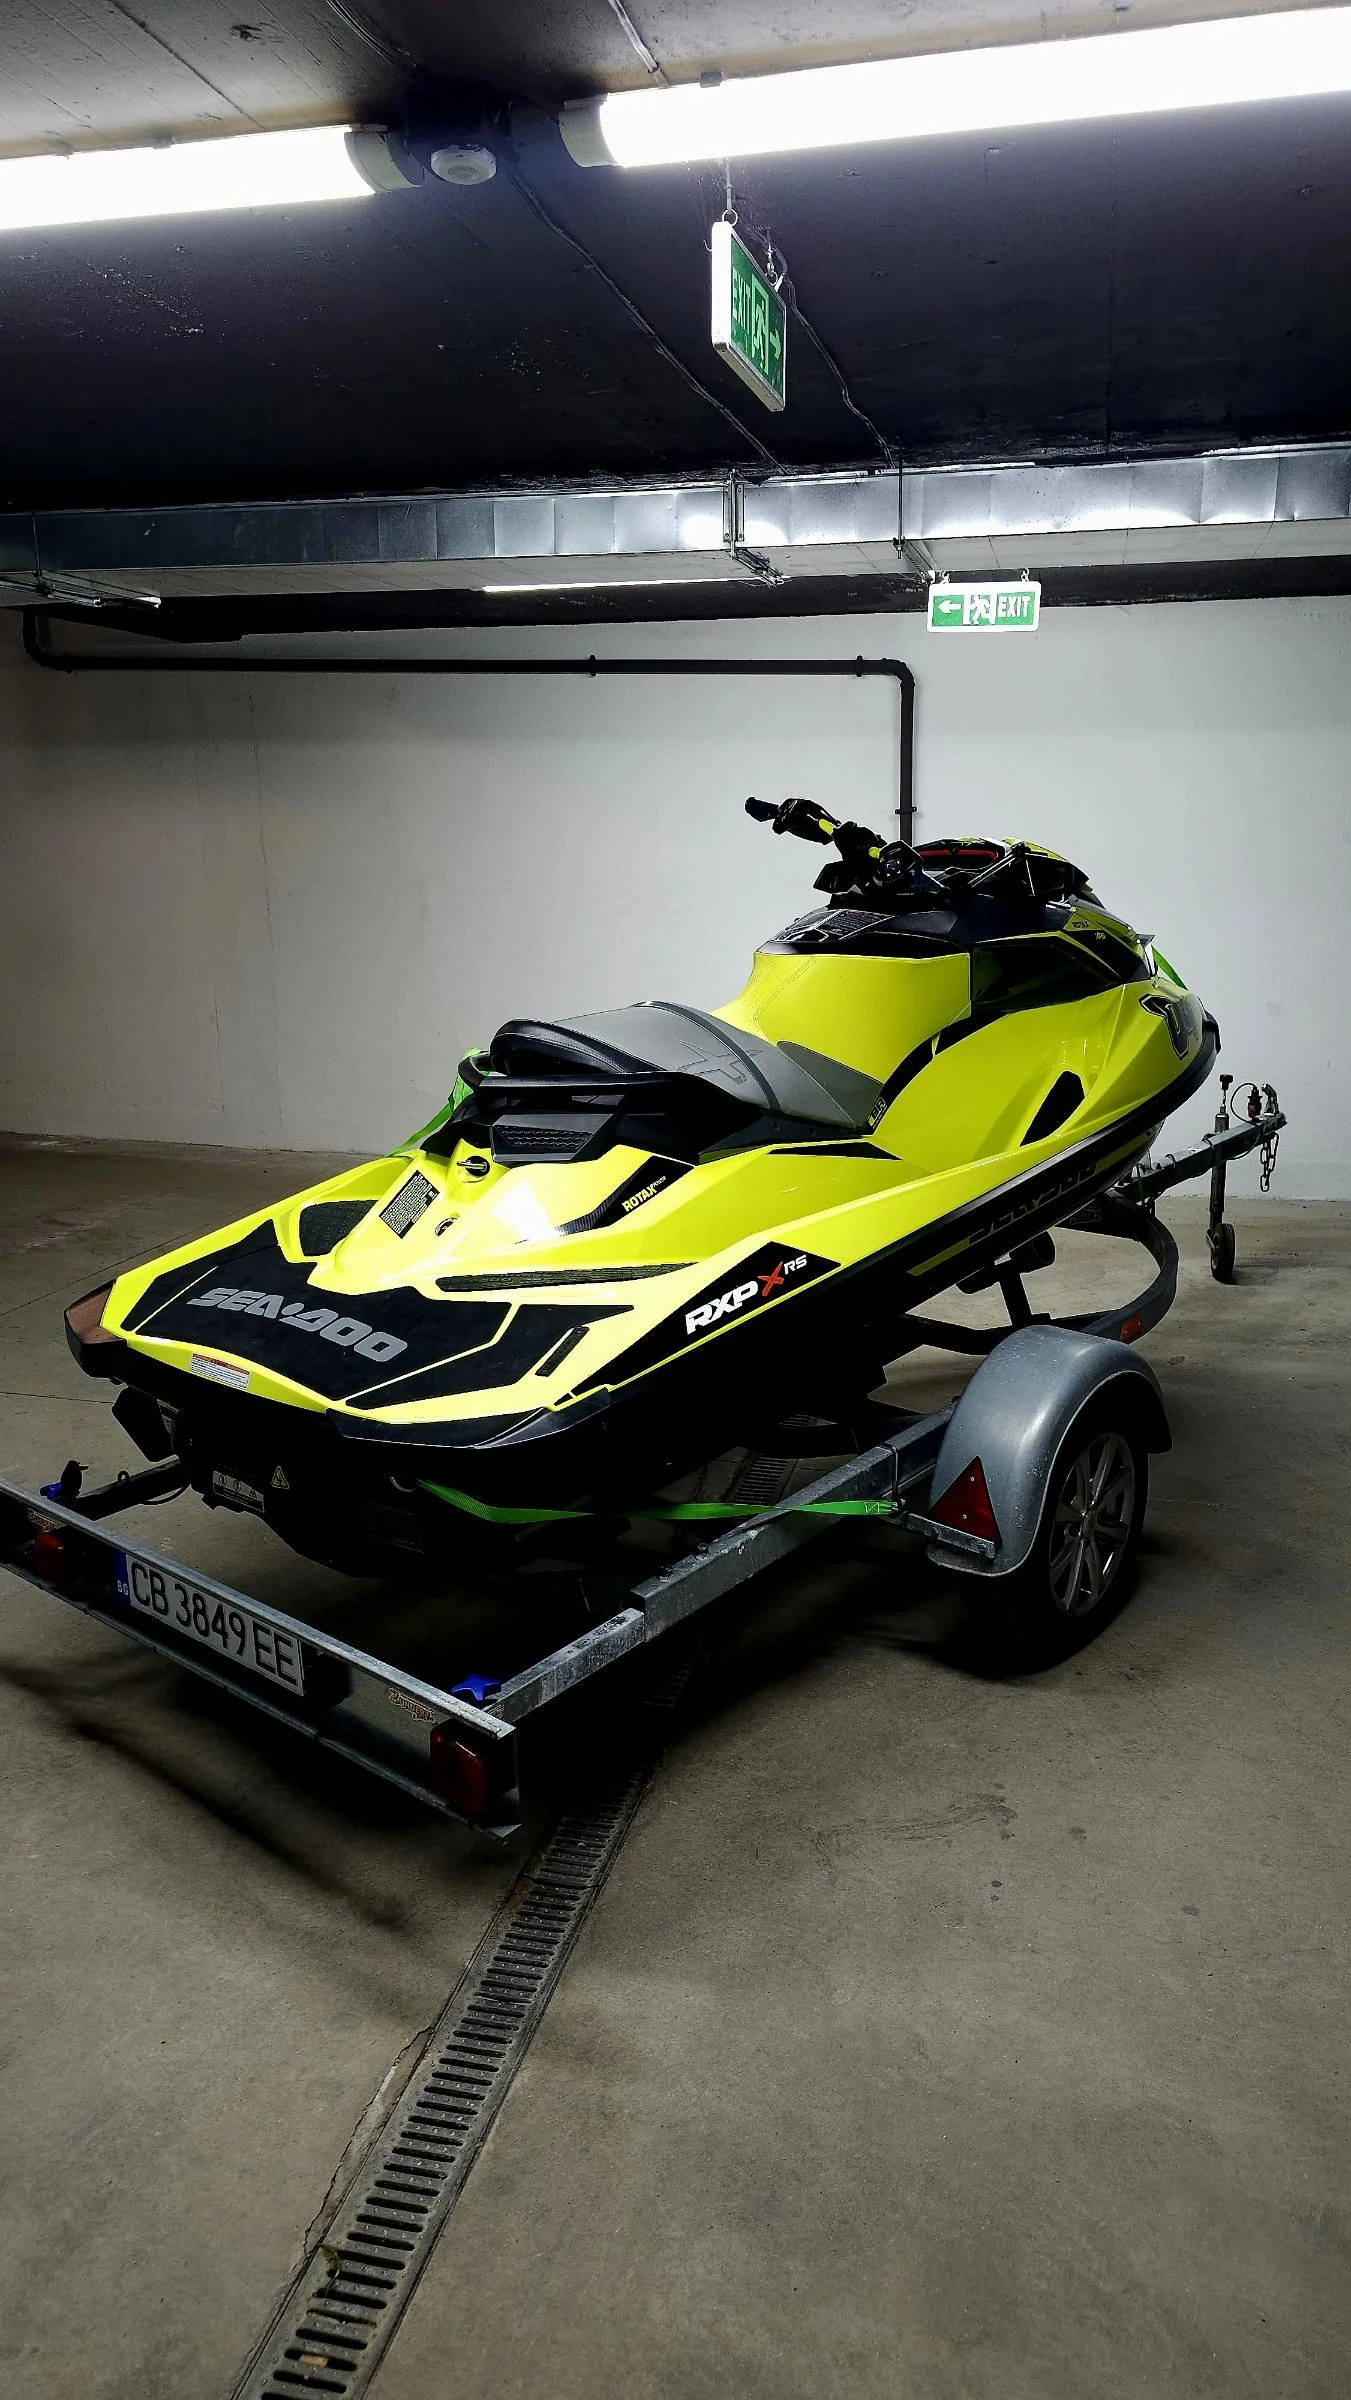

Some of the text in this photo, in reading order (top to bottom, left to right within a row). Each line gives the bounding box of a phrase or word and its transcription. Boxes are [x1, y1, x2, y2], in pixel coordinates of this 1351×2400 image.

[732, 267, 751, 335] EXIT
[997, 595, 1031, 618] EXIT
[621, 1183, 658, 1212] ROTAX
[685, 1254, 808, 1335] RXP X RS
[117, 1579, 129, 1596] BG
[174, 1582, 247, 1658] 3849
[252, 1620, 299, 1687] EE
